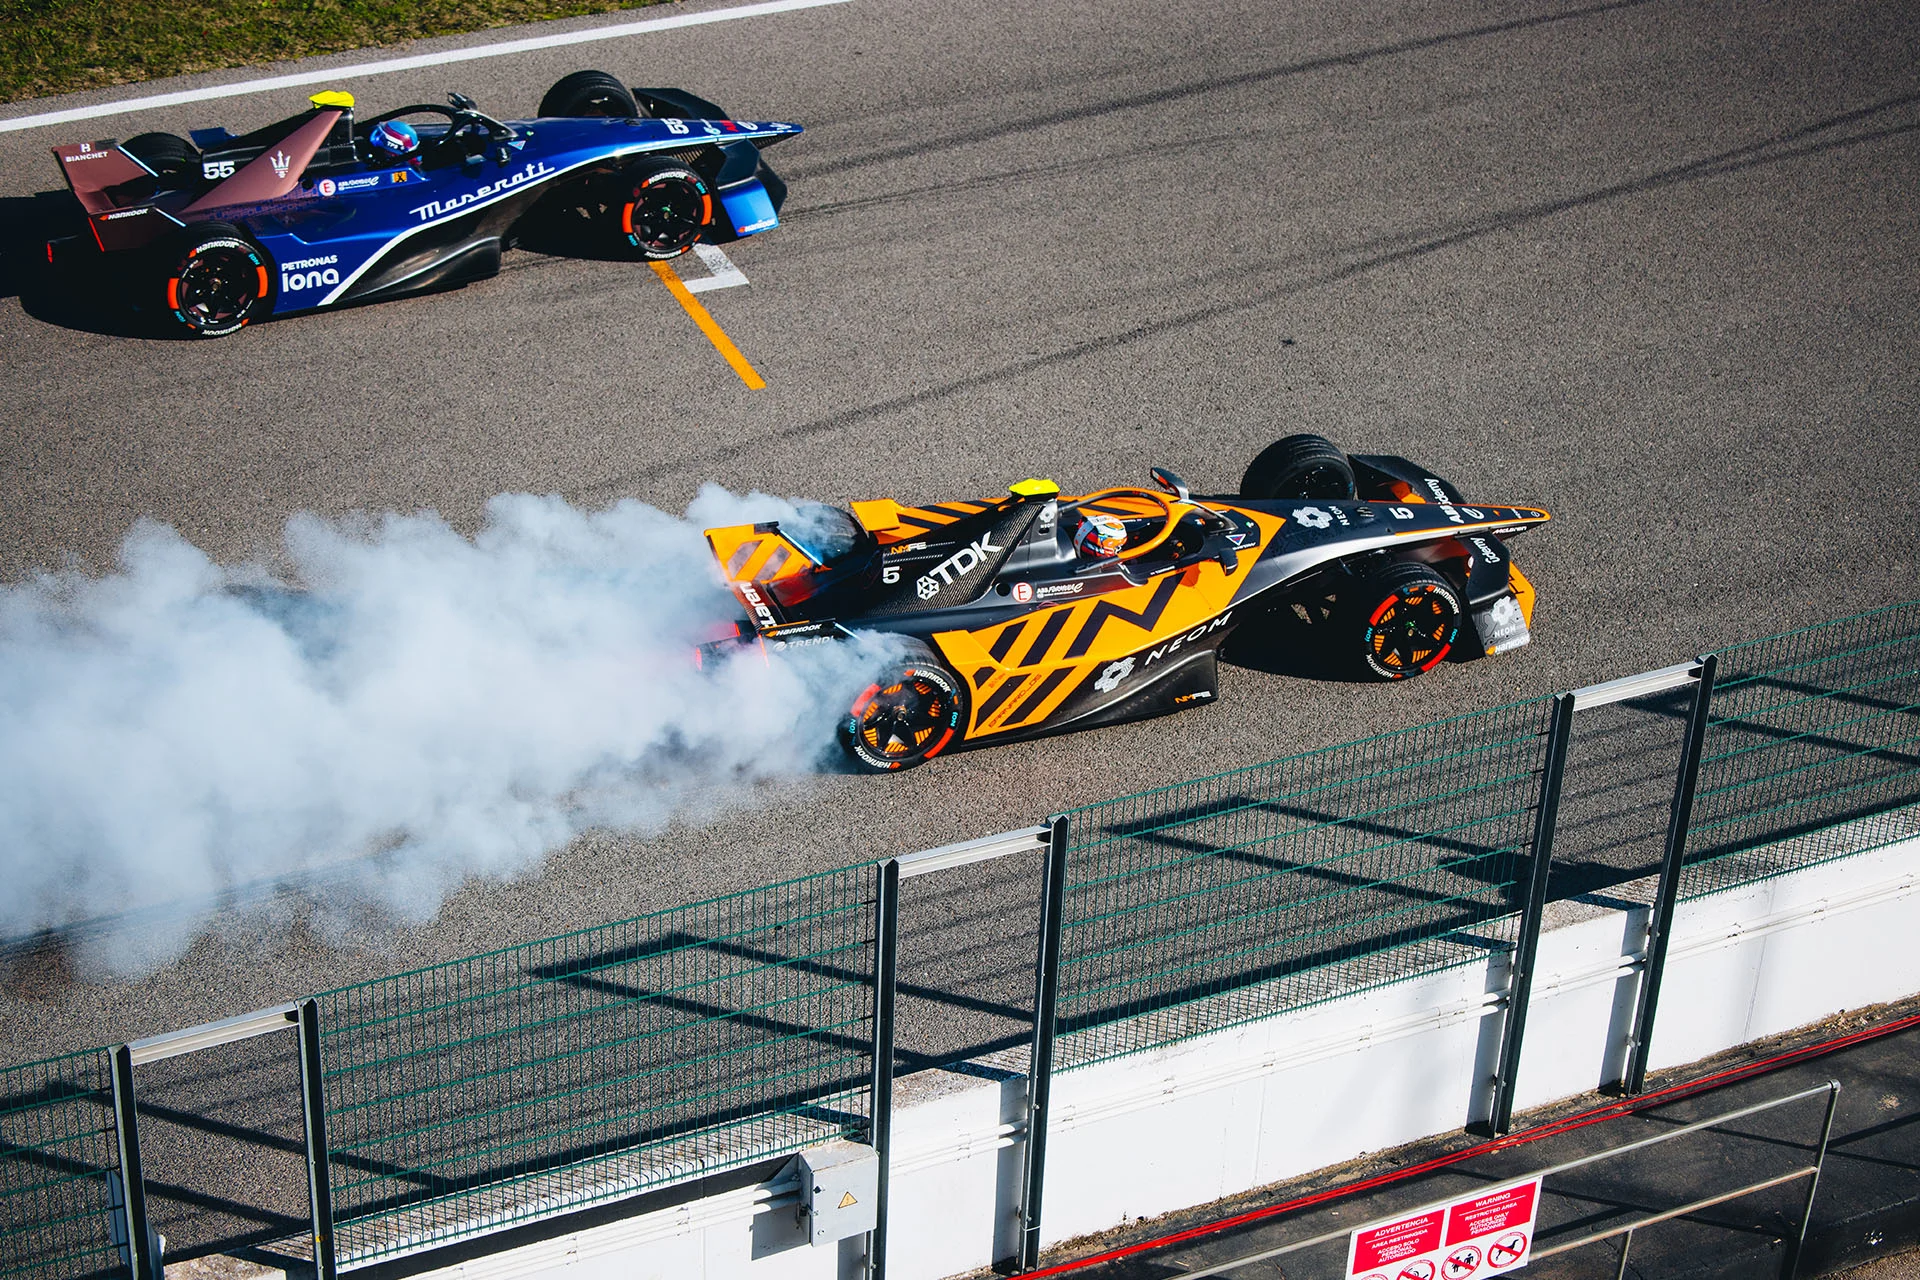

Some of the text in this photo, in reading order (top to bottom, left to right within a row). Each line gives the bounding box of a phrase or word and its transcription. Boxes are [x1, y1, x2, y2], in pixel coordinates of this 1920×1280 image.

[65, 151, 108, 163] BIANCHET
[203, 161, 236, 180] 55
[409, 161, 556, 221] Maserati
[108, 208, 149, 220] Hankook
[196, 240, 240, 254] Hankook
[281, 254, 338, 272] PETRONAS
[282, 268, 340, 293] iona
[1388, 506, 1415, 520] 5
[1491, 526, 1528, 534] McLaren
[929, 531, 1004, 585] TDK
[882, 566, 900, 584] 5
[1433, 587, 1460, 615] Hankook
[776, 624, 822, 636] Hankook
[1145, 611, 1233, 666] NEOM
[1365, 654, 1395, 679] Hankook
[913, 670, 952, 693] Hankook
[854, 745, 892, 769] Hankook
[1475, 1192, 1511, 1208] WARNING
[1464, 1202, 1517, 1221] RESTRICTED AREA
[1469, 1211, 1510, 1227] ACCESS ONLY
[1374, 1217, 1429, 1238] ADVERTENCIA
[1371, 1229, 1428, 1249] AREA RESTRINGIDA
[1377, 1238, 1420, 1255] ACCESO SOLO
[1378, 1248, 1416, 1263] AUTORIZADO
